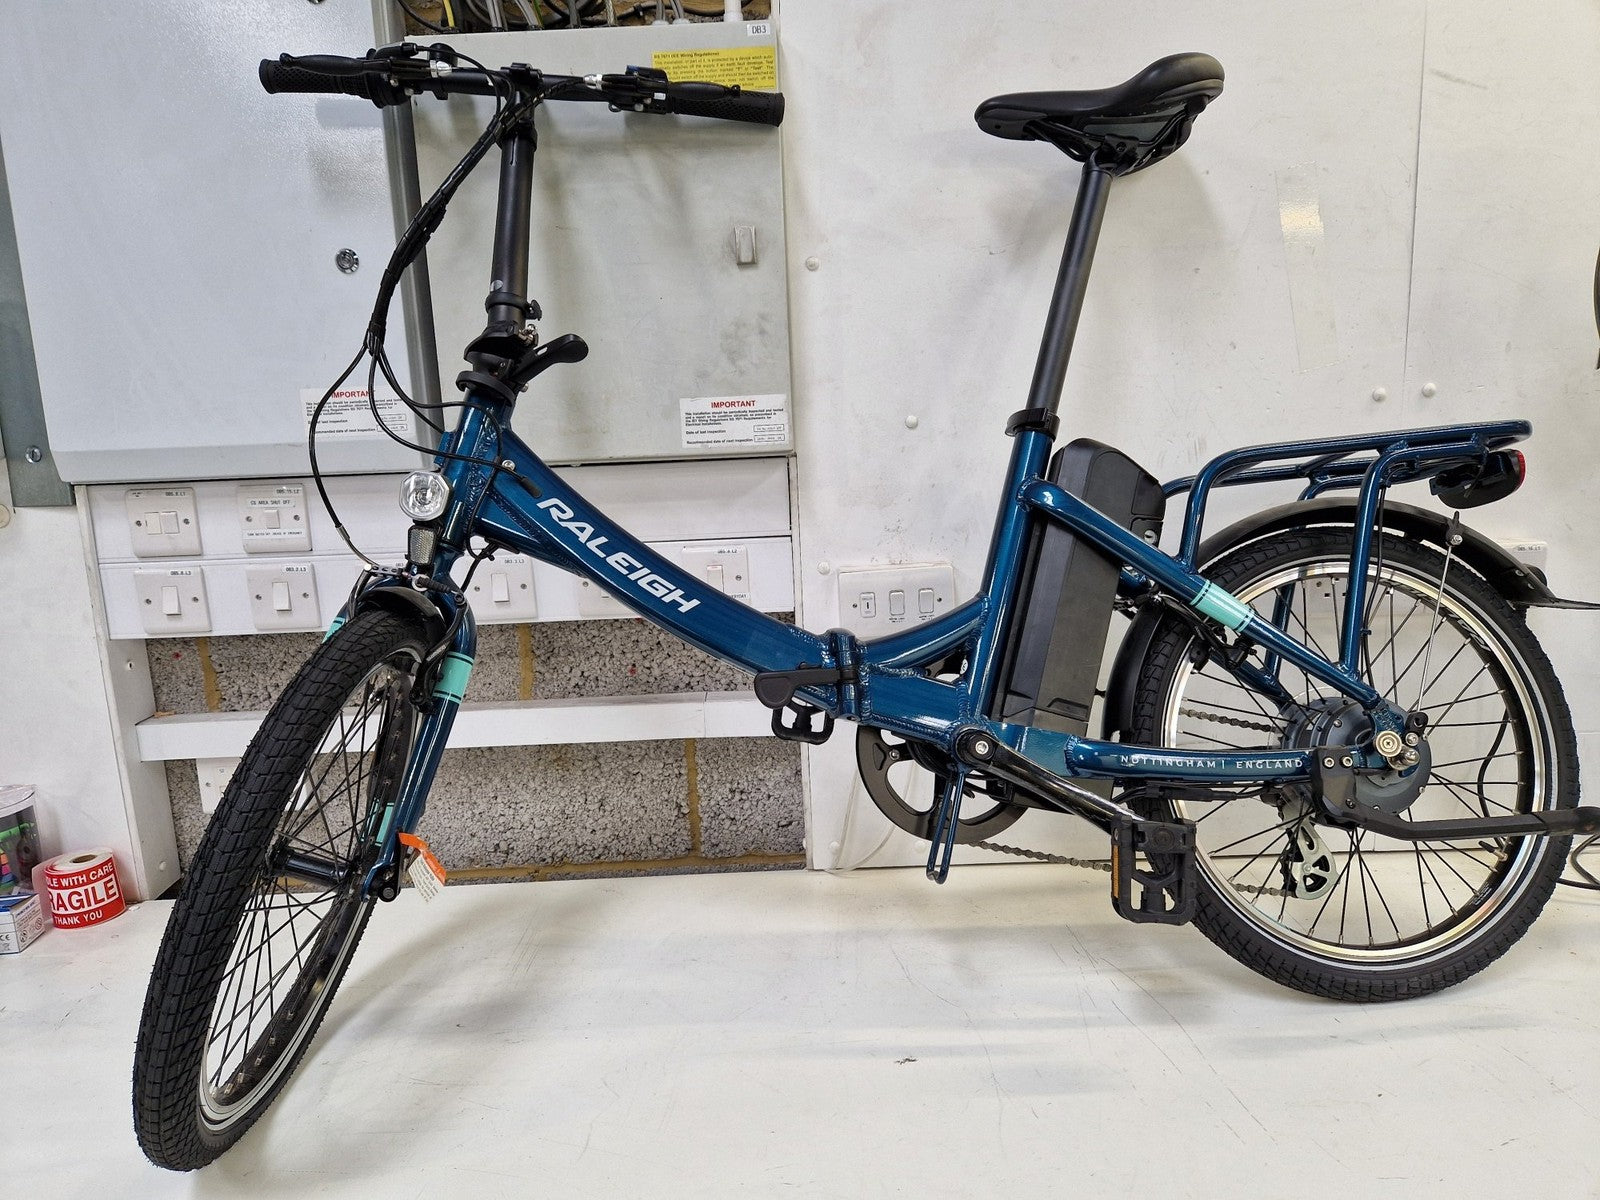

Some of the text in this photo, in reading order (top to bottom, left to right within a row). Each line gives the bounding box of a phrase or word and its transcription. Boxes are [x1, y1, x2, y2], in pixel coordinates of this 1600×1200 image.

[752, 25, 766, 34] DB3
[332, 390, 376, 398] IMPORTAN
[711, 400, 756, 408] IMPORTANT
[536, 498, 701, 614] RALEIGH
[1120, 755, 1304, 769] NOTTINGHAM ENGLAND
[60, 874, 87, 888] WITH
[89, 862, 113, 880] CARE
[55, 913, 80, 926] THANK
[83, 910, 103, 922] YOU
